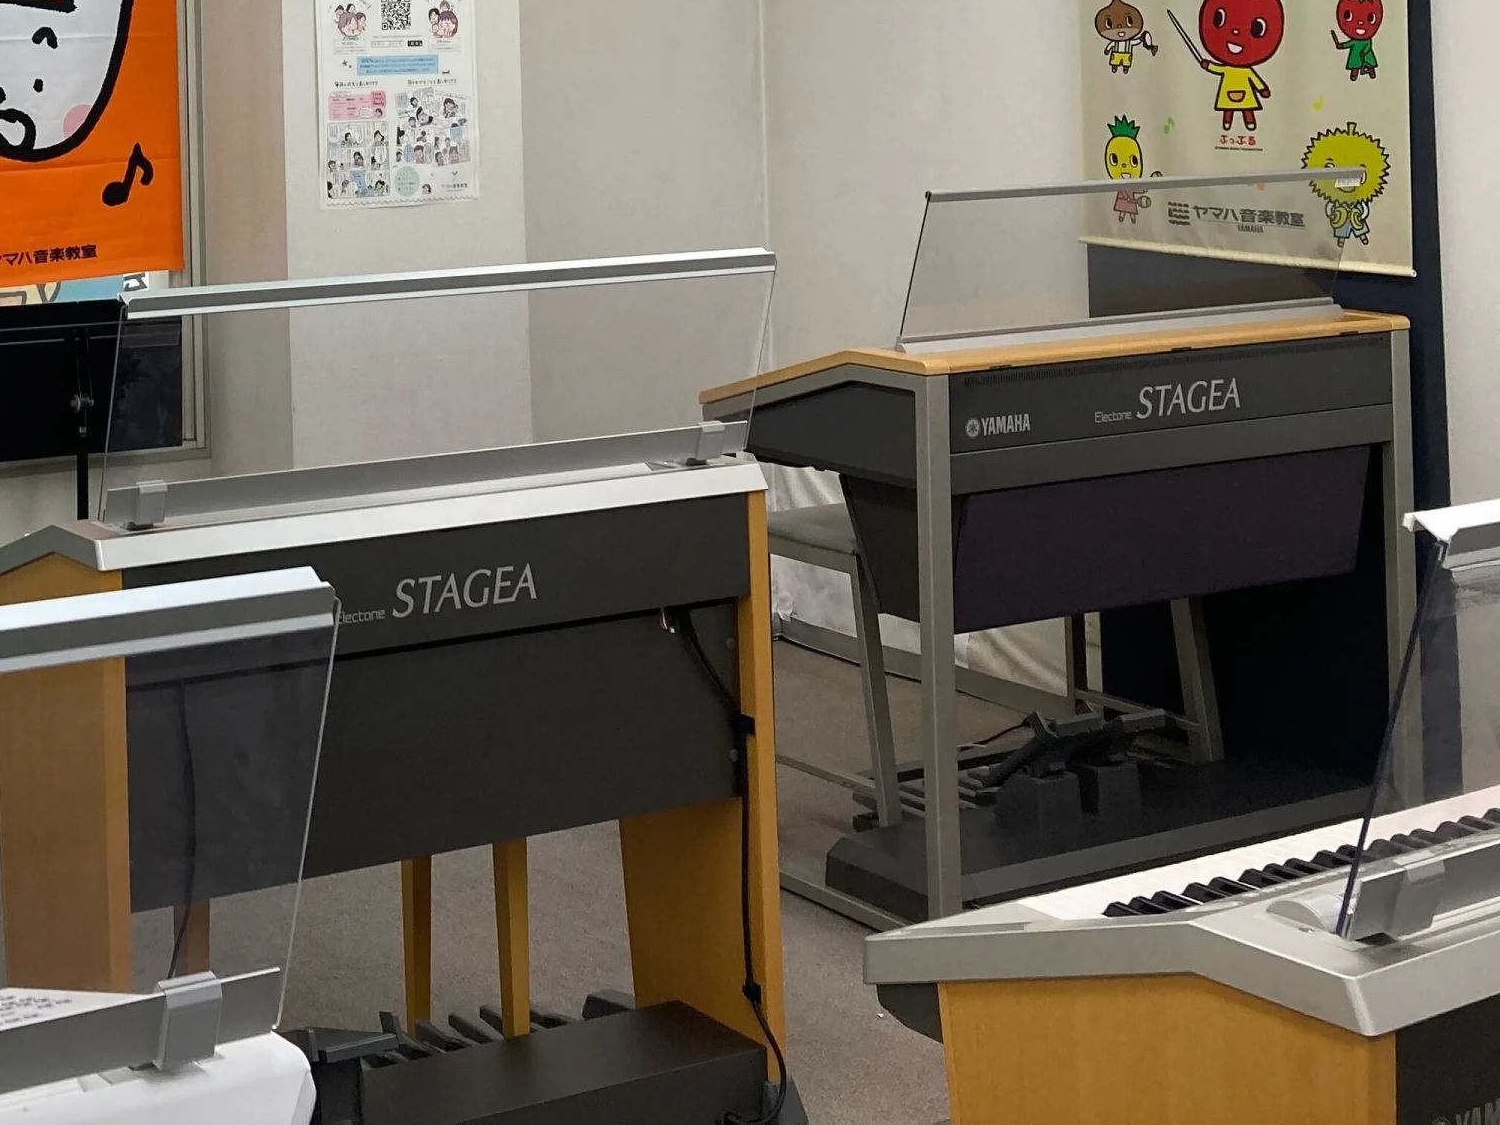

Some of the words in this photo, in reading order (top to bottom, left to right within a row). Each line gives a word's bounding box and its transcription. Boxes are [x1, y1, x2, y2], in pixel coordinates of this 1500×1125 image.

[1192, 205, 1306, 227] ヤマハ音楽教室
[1237, 224, 1264, 233] YAMAHA
[1094, 410, 1132, 423] Electone
[1136, 378, 1241, 419] STAGEA
[981, 413, 1031, 436] YAMAHA
[392, 562, 538, 619] STAGEA
